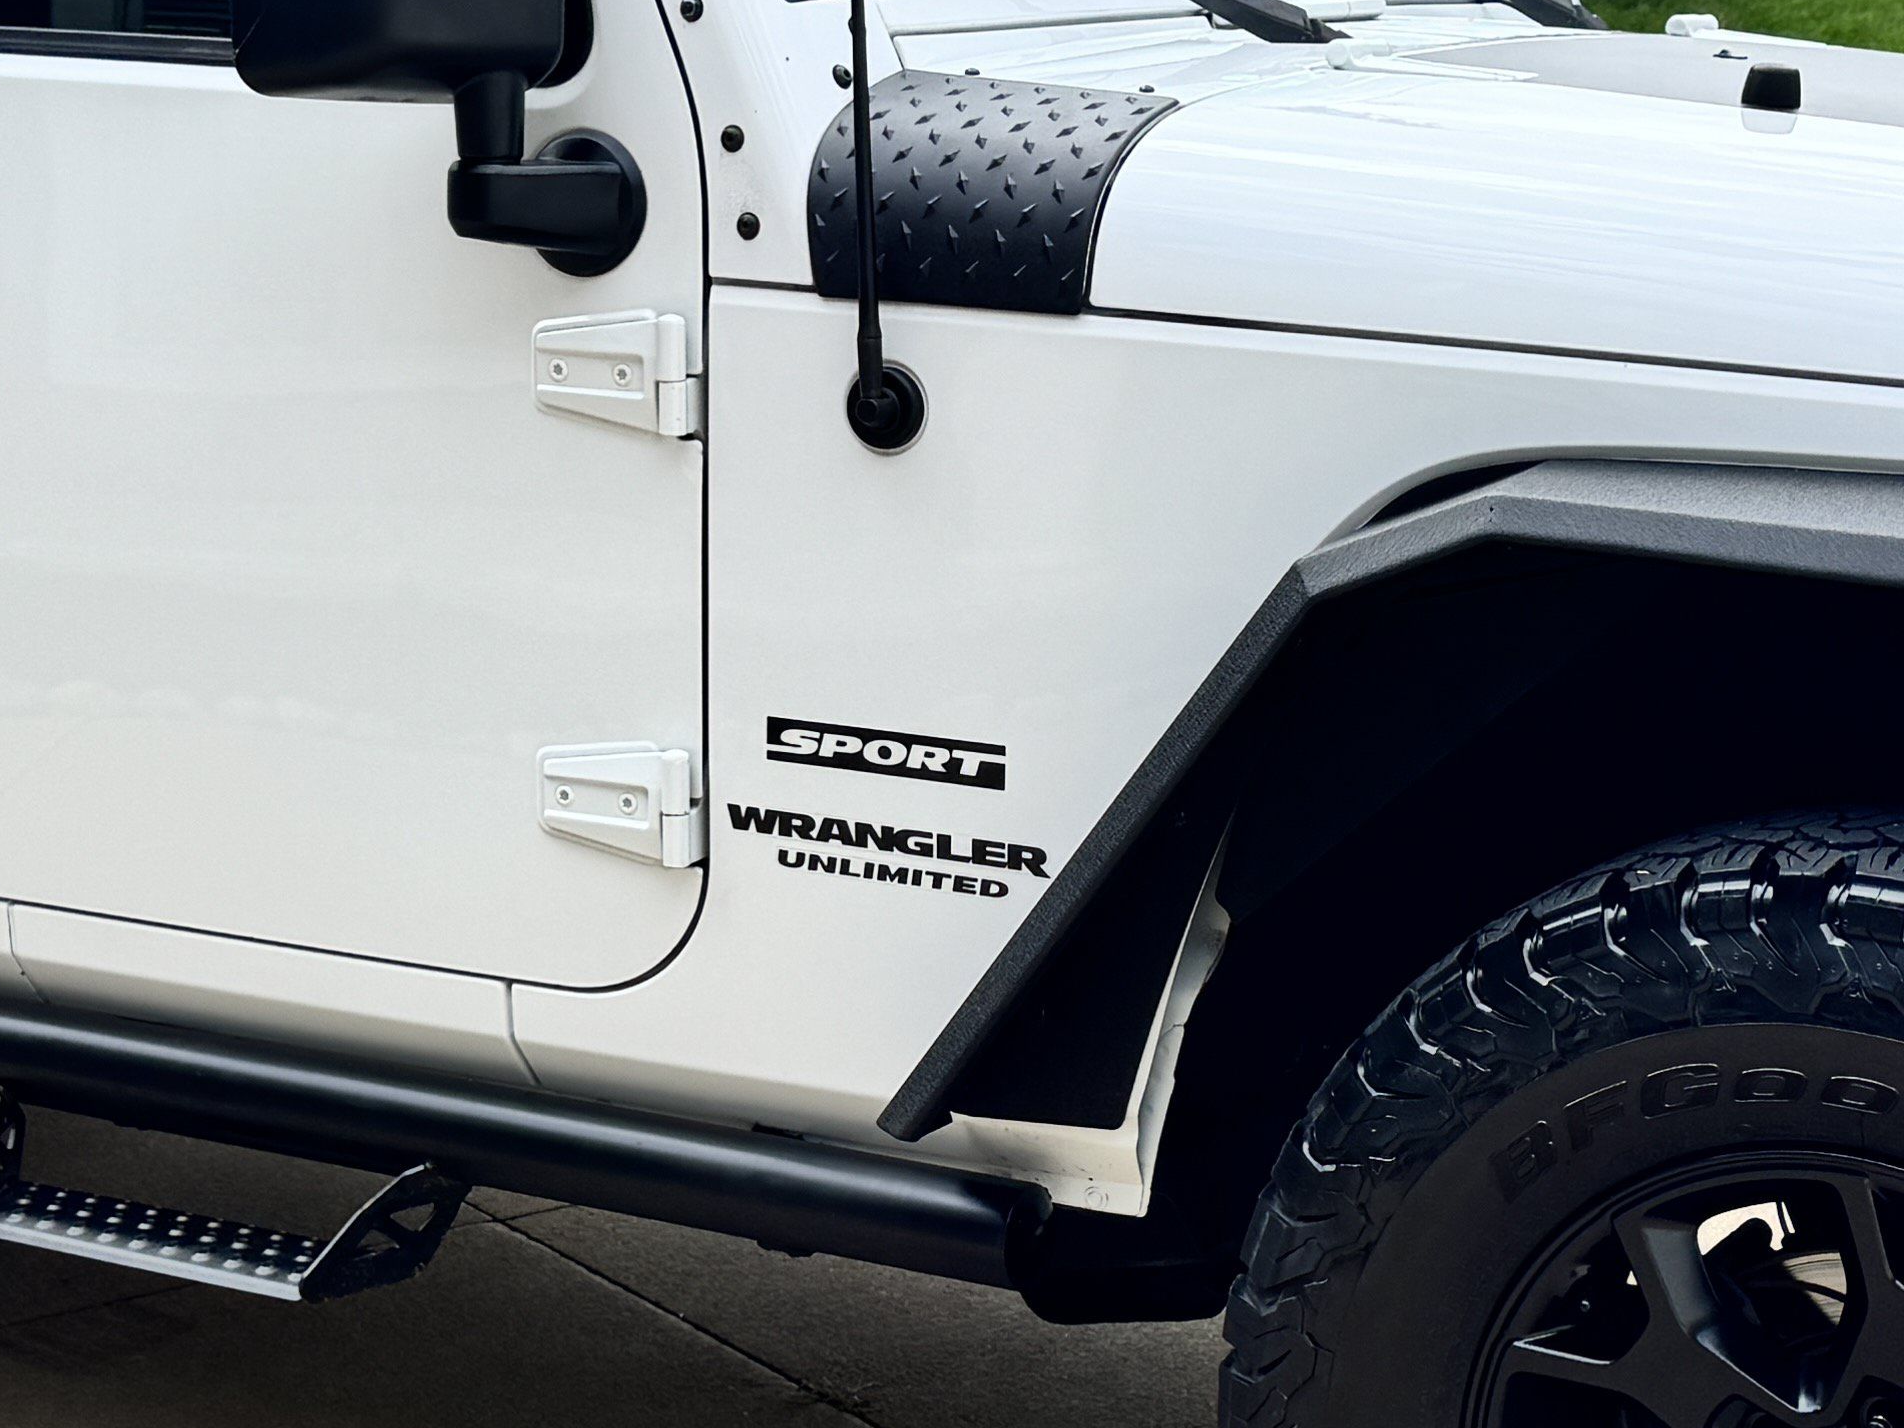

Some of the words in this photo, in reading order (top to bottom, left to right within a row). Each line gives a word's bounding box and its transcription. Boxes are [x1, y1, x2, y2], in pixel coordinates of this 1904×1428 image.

[768, 727, 1007, 778] SPORT
[726, 802, 1052, 879] WRANGLER
[777, 848, 1010, 899] UNLIMITED
